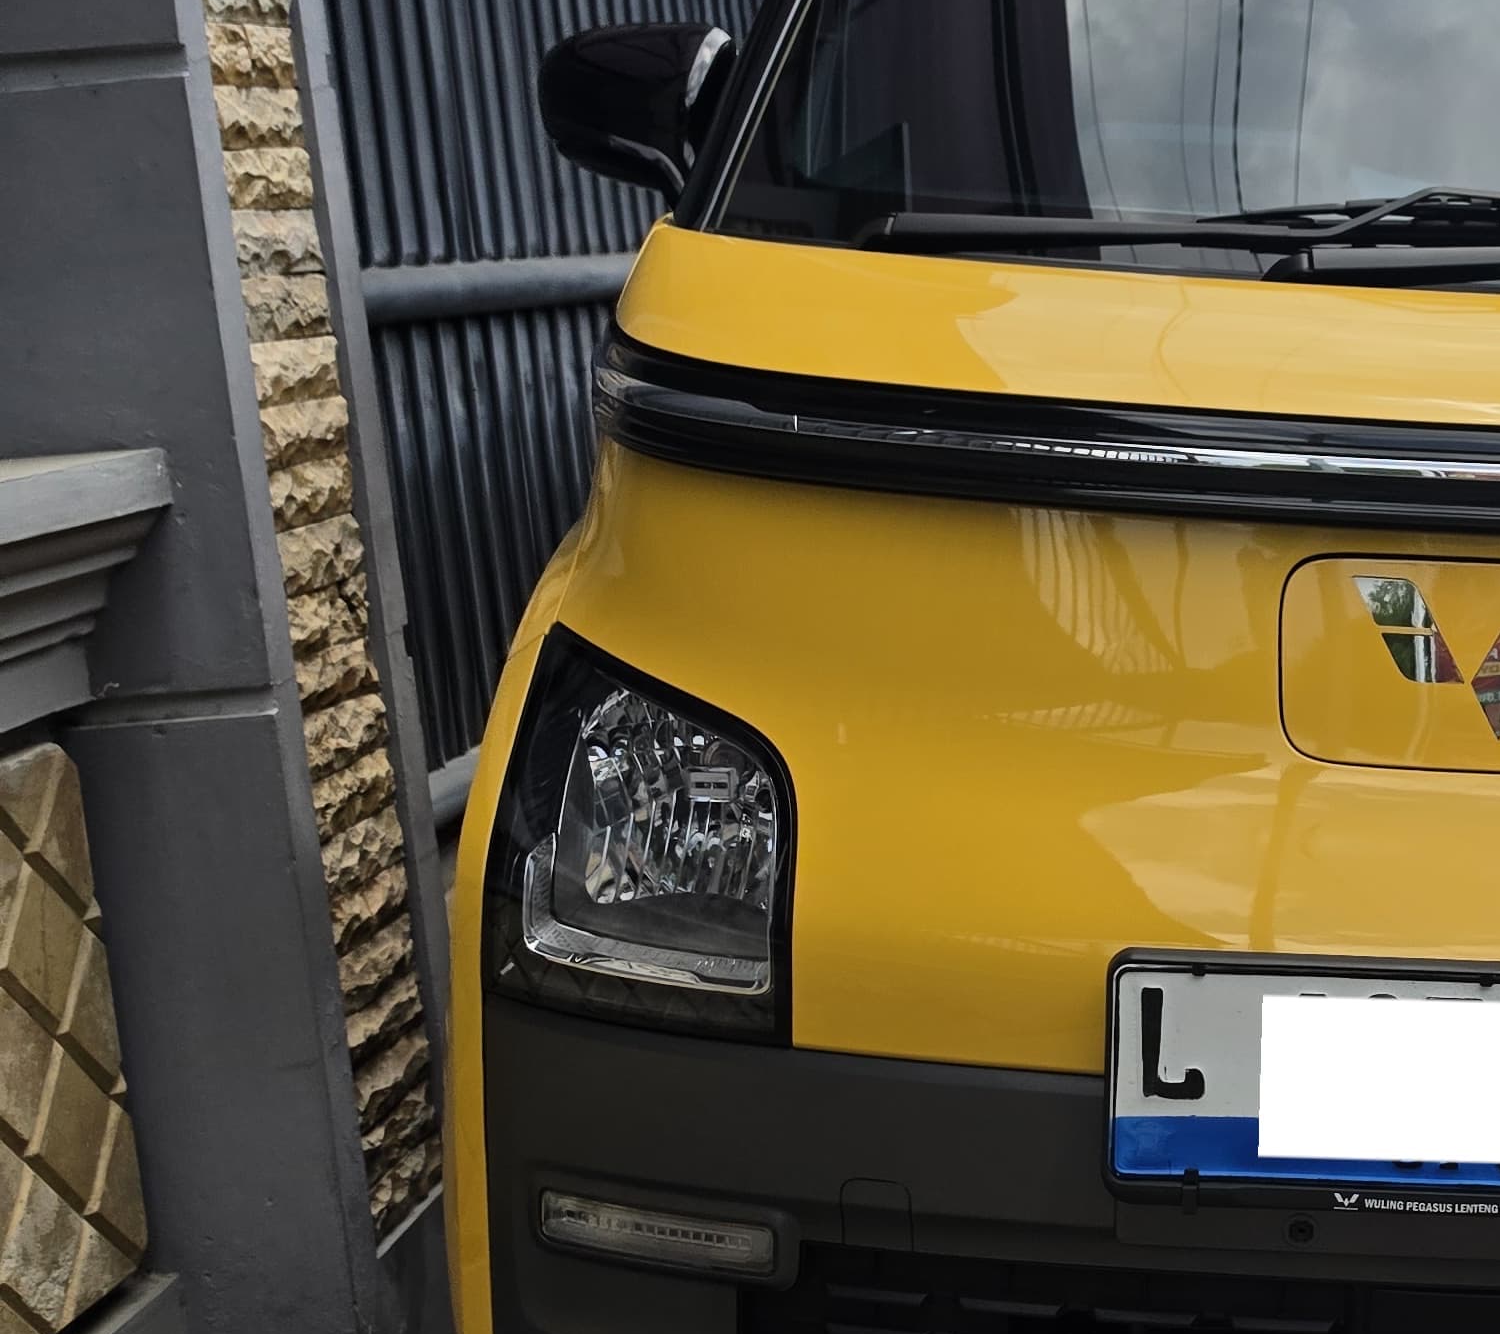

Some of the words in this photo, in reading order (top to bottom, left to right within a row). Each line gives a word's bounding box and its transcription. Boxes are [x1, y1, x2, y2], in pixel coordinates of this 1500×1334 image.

[1141, 987, 1206, 1100] L
[1364, 1198, 1404, 1211] WULING
[1405, 1201, 1452, 1213] PEGASUS
[1454, 1203, 1499, 1214] LENTENG
